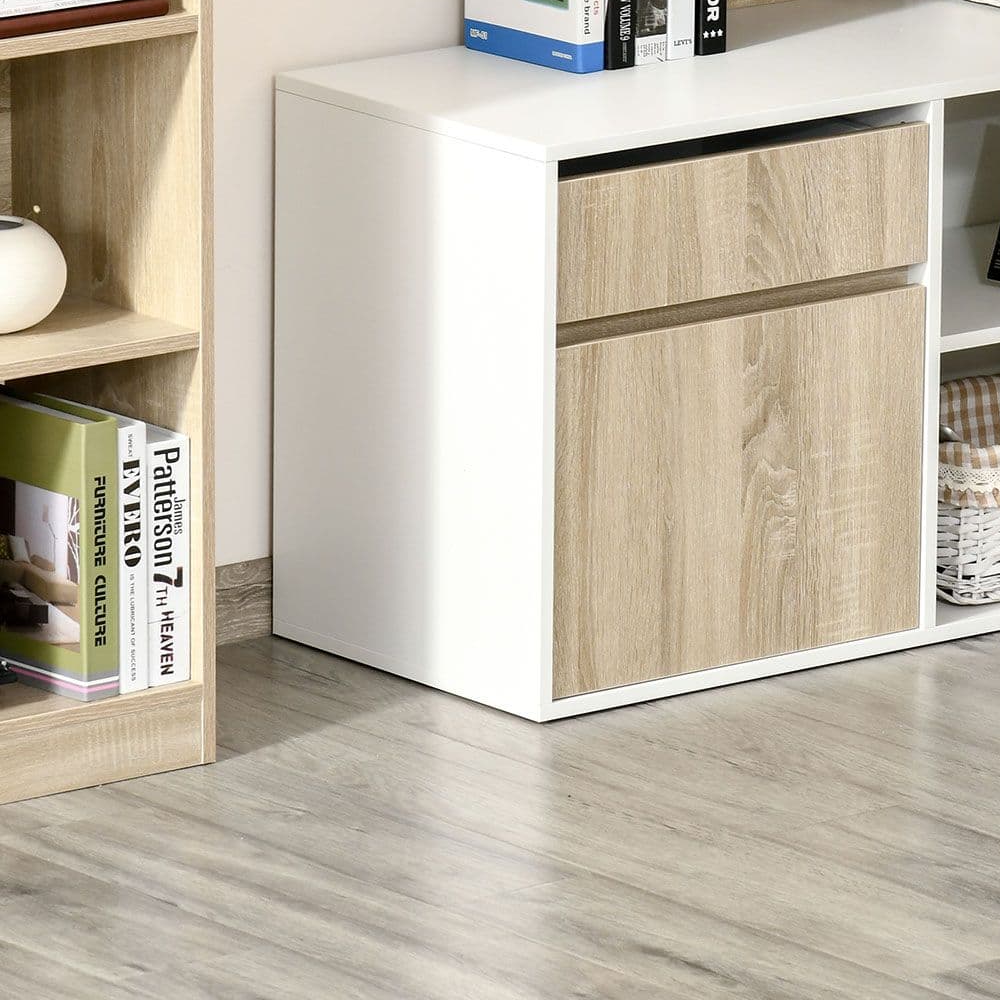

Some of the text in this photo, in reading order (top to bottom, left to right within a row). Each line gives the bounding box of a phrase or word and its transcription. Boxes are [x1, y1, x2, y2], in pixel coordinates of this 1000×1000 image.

[583, 6, 592, 35] brand
[123, 459, 141, 567] EVERO
[153, 447, 180, 567] Patterson
[173, 497, 186, 535] James
[94, 574, 107, 647] CULTURE
[160, 610, 175, 676] HEAVEN
